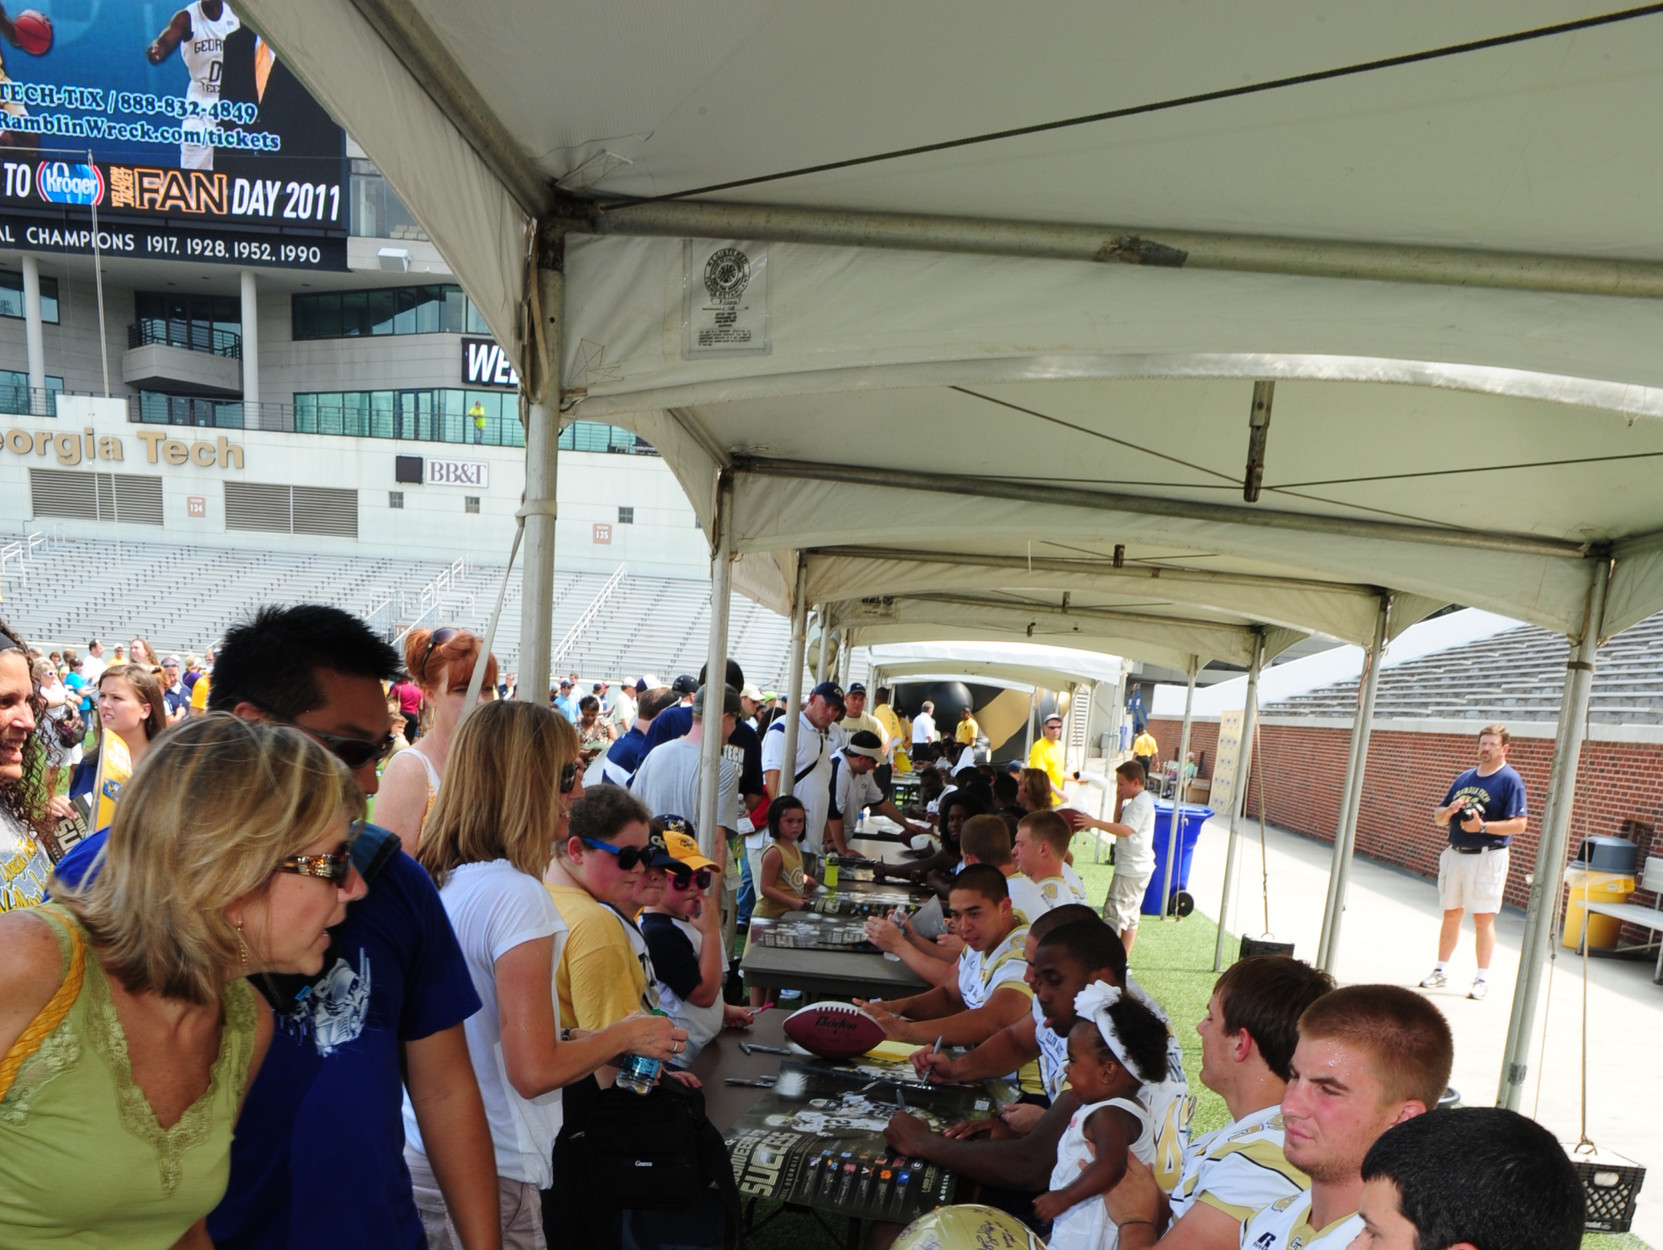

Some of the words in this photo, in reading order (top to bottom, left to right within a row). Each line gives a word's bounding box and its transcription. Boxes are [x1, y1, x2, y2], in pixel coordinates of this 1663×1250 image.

[118, 93, 258, 124] 888-832-4849
[3, 162, 32, 198] TO
[45, 162, 98, 203] Kroger
[134, 167, 227, 215] FAN
[232, 178, 282, 217] DAY
[283, 181, 341, 222] 2011
[26, 226, 135, 251] CHAMPIONS
[281, 244, 321, 264] 1990
[137, 430, 244, 469] Tech
[429, 461, 486, 485] BB&T
